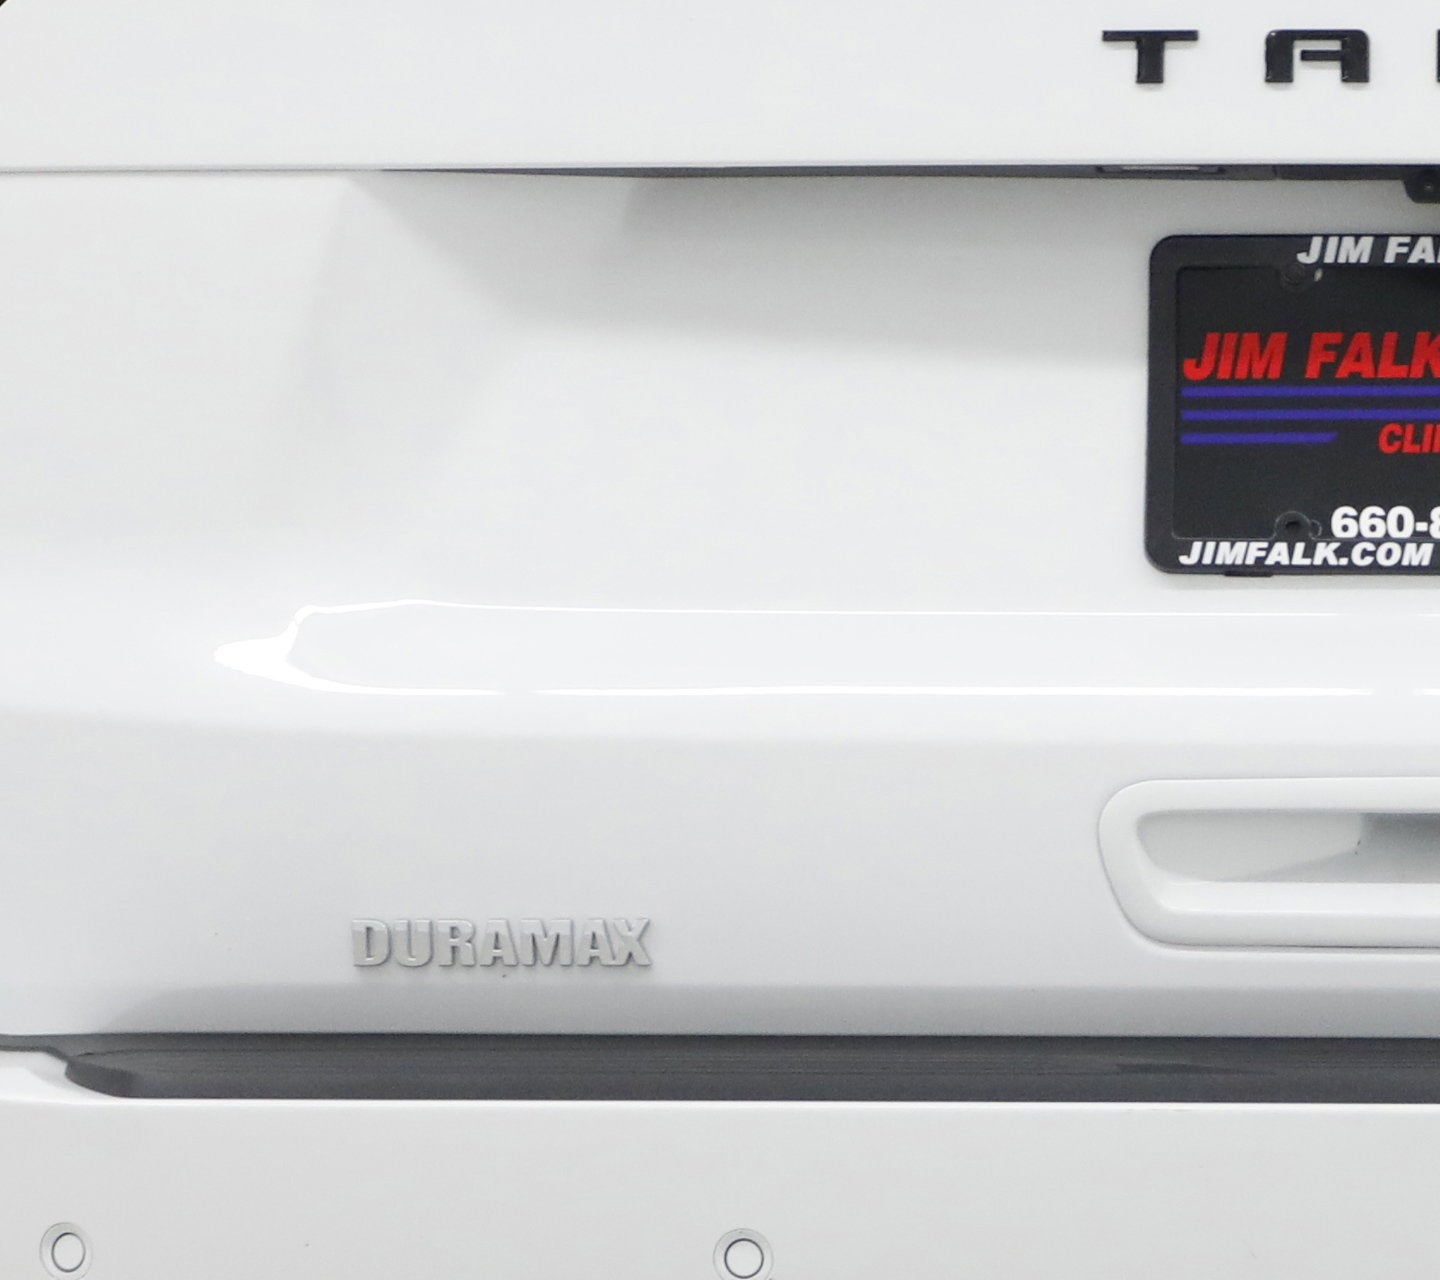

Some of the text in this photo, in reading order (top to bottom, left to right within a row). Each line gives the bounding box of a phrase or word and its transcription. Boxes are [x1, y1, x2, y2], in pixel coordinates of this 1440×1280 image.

[1296, 235, 1374, 265] JIM
[1182, 332, 1288, 381] JIM
[1178, 541, 1435, 567] JIMFALK.COM
[351, 919, 654, 968] DURAMAX
